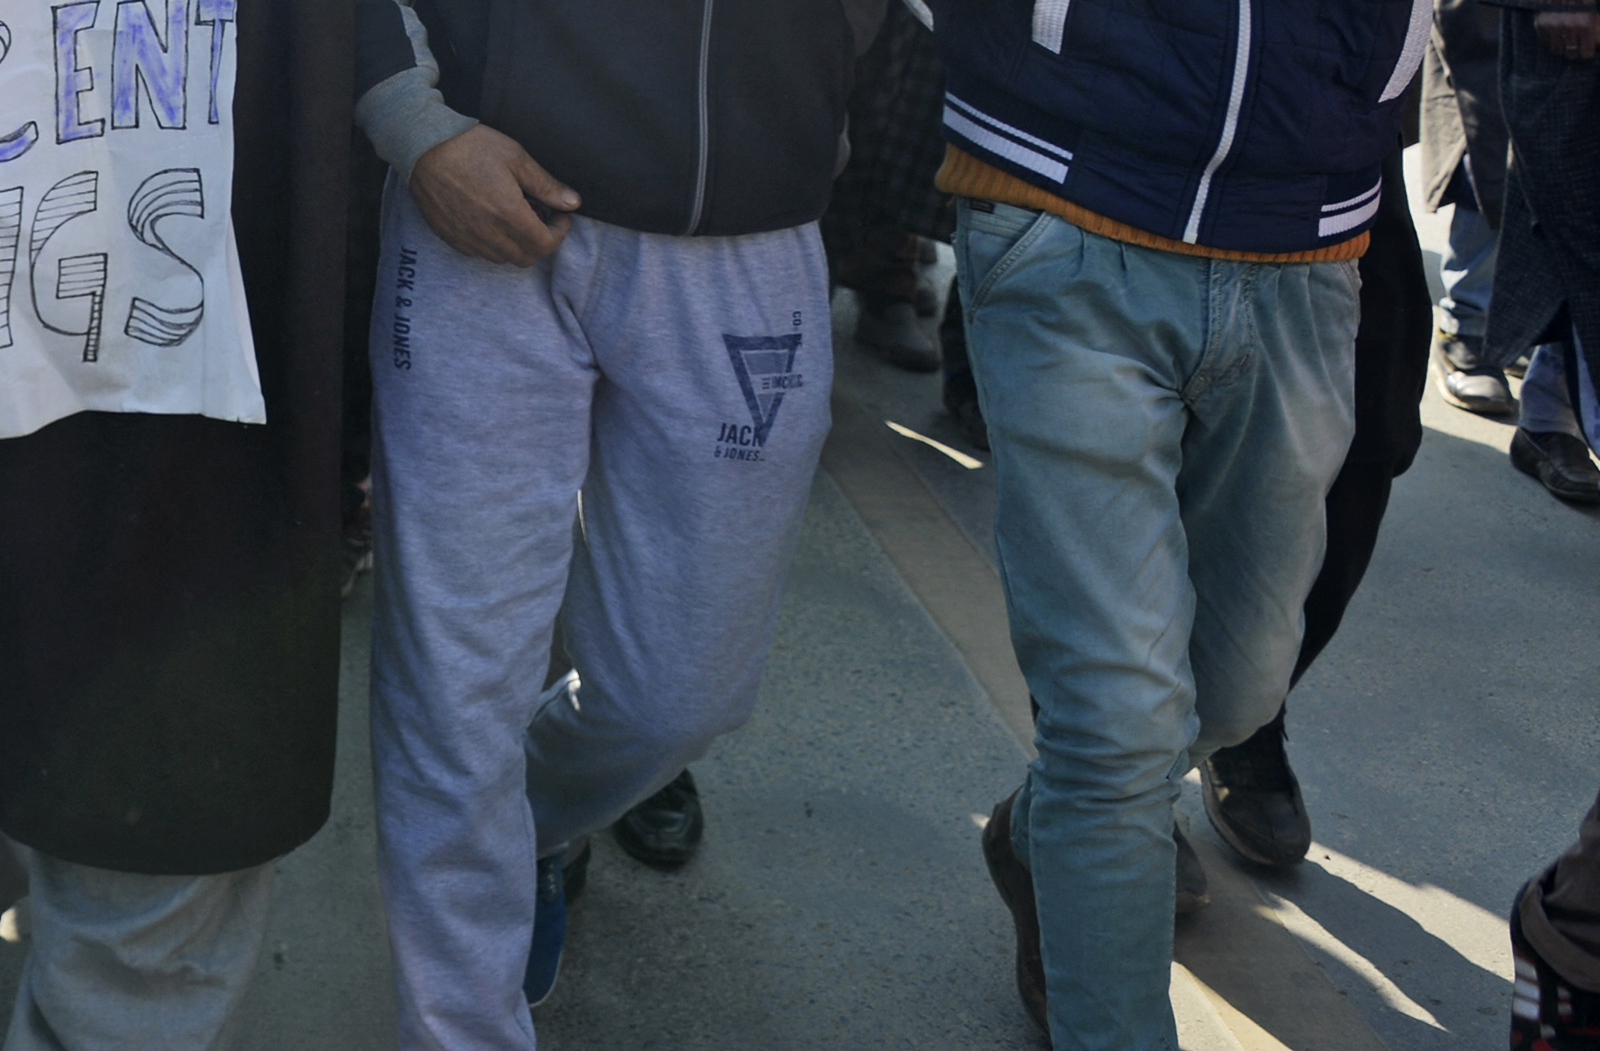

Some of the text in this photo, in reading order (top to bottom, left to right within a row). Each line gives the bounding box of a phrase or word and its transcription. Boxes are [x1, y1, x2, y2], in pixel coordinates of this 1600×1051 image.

[392, 246, 418, 371] JACK & JONES
[717, 423, 764, 447] JACK
